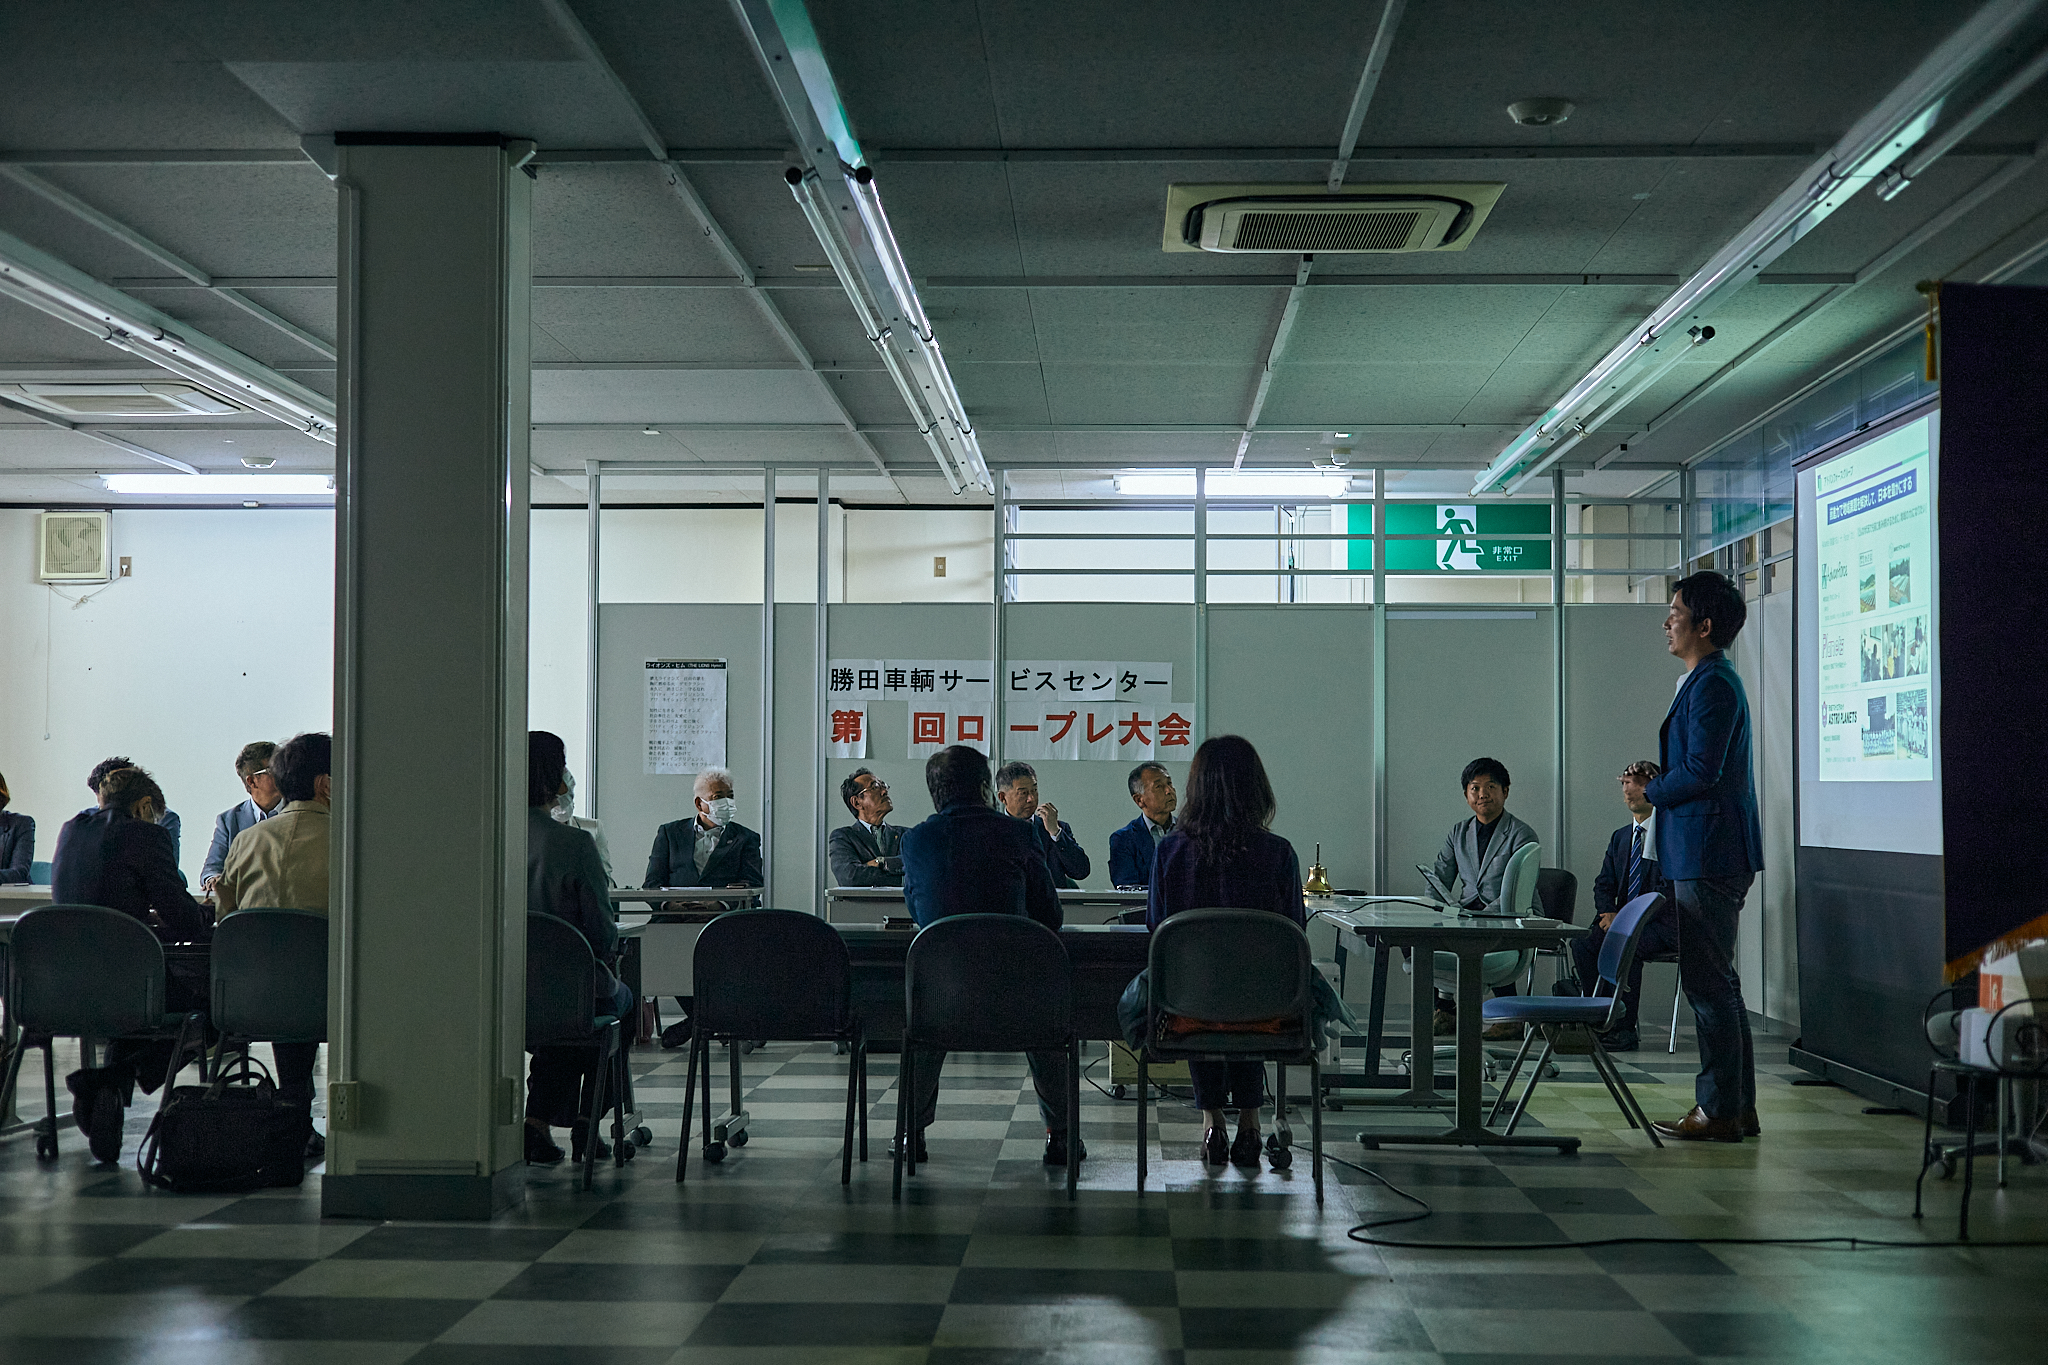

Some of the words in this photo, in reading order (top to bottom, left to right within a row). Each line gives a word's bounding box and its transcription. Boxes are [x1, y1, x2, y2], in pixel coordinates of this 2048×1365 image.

[1492, 546, 1523, 555] 非常口
[830, 710, 864, 744] 第
[913, 710, 1192, 747] 回ロープレ大会
